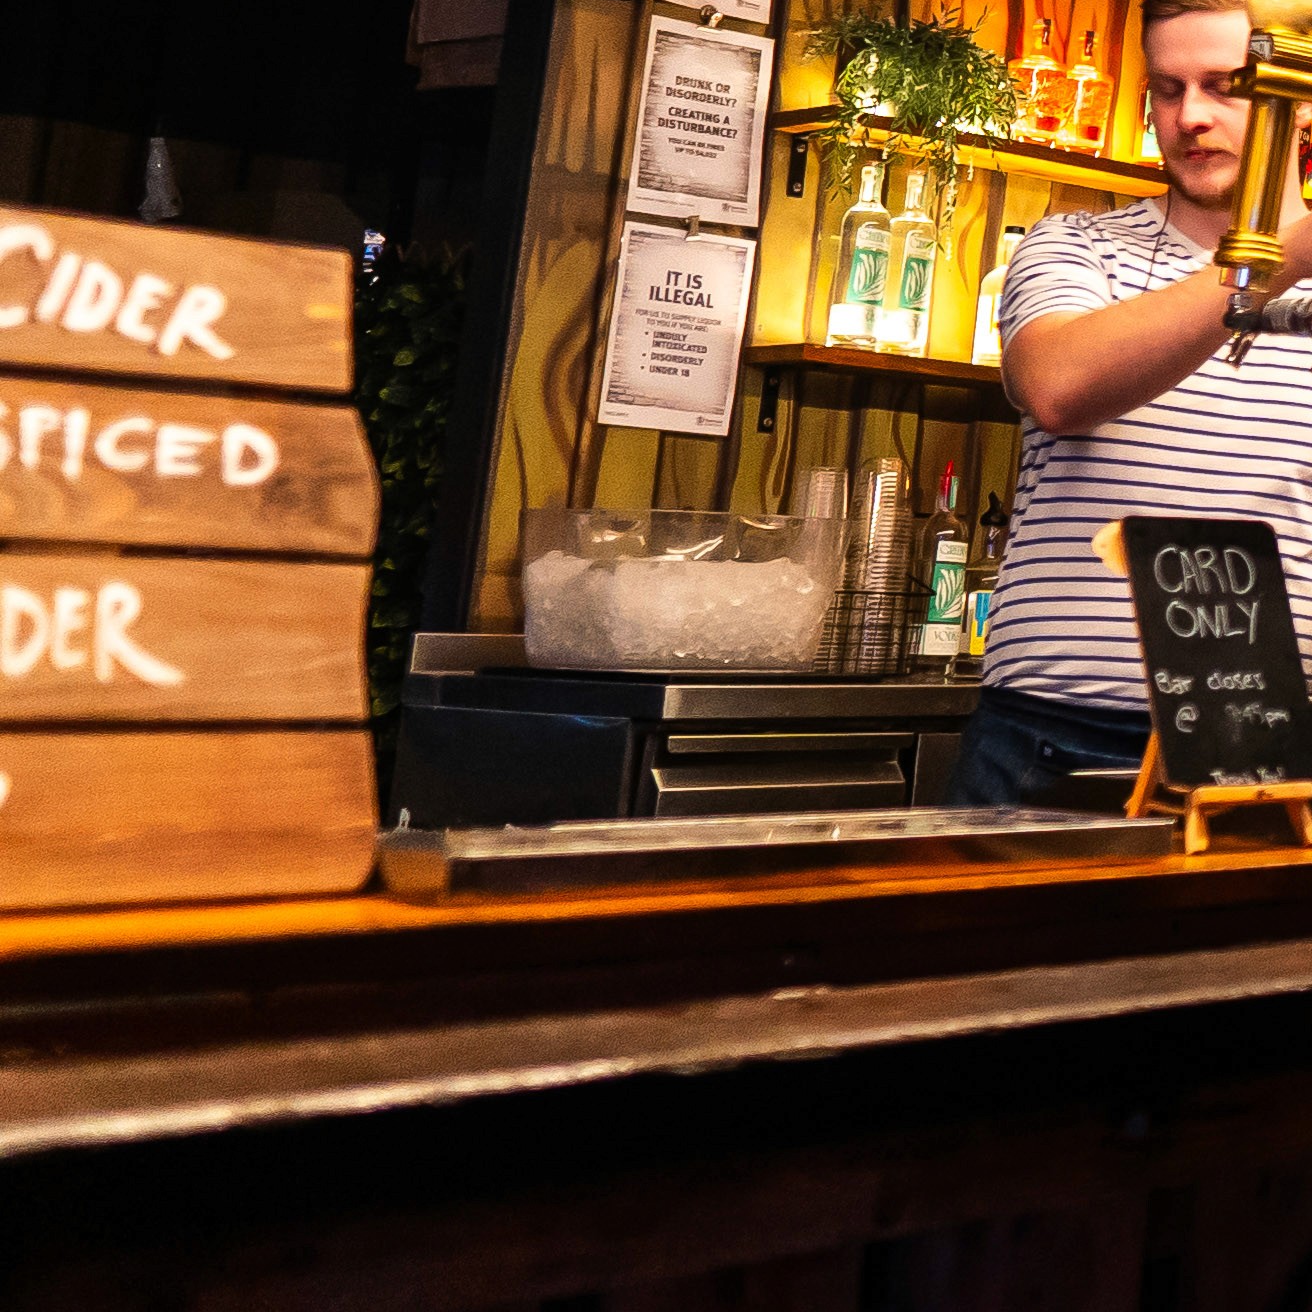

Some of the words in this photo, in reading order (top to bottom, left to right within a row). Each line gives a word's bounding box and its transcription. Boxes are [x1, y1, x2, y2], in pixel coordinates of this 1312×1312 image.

[675, 75, 712, 91] DRUNK
[716, 83, 731, 94] OR
[665, 86, 738, 108] DISORDERLY?
[668, 106, 721, 124] CREATING
[723, 115, 730, 125] A
[657, 117, 738, 139] DISTURBANCE?
[666, 269, 683, 287] IT
[686, 273, 703, 290] IS
[0, 223, 236, 361] CIDER
[649, 285, 714, 309] ILLEGAL
[652, 339, 708, 354] INTOXICATED
[653, 331, 688, 342] UNDULY
[650, 352, 704, 367] DISORDERLY
[649, 365, 679, 376] UNDER
[681, 368, 690, 378] 18
[0, 400, 281, 488] PICED
[1153, 543, 1257, 595] CARD
[1165, 599, 1260, 645] ONLY
